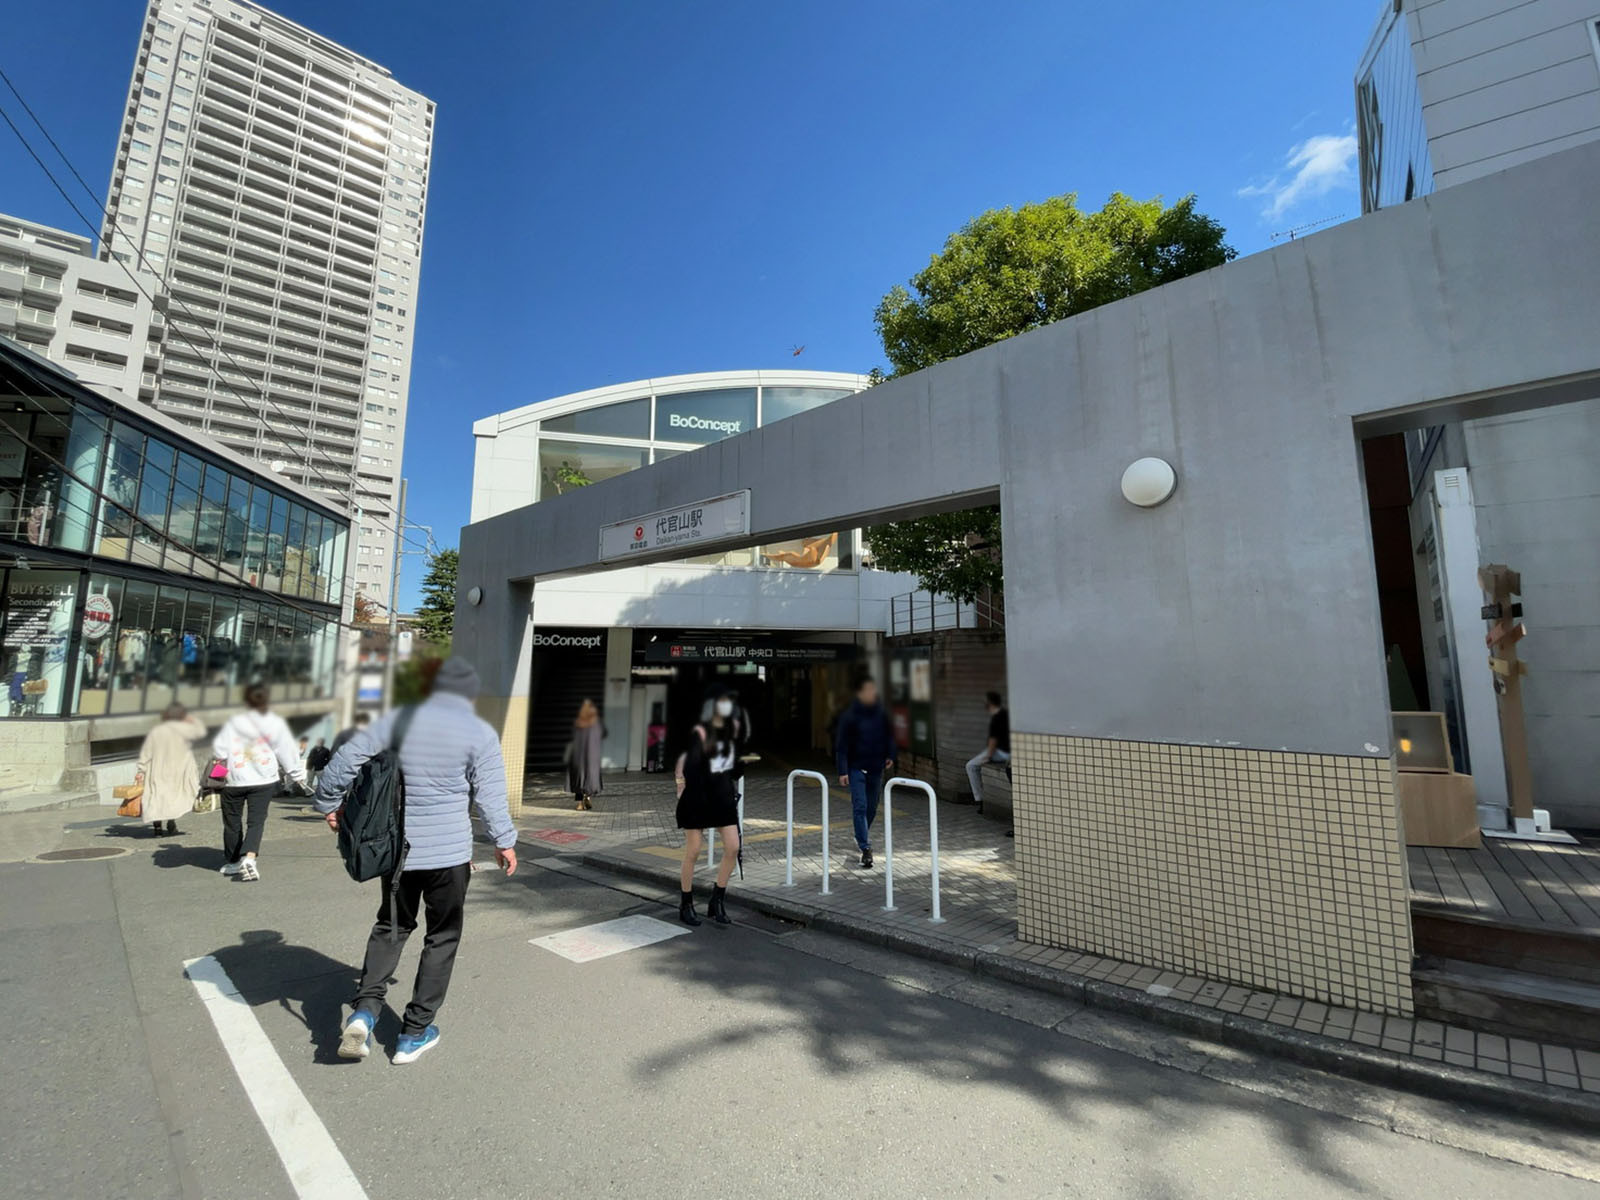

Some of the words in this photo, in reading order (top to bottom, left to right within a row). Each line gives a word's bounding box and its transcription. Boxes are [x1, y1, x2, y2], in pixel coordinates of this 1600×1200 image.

[670, 414, 741, 434] BoConcept
[656, 509, 703, 536] 代官山駅
[9, 598, 63, 607] Secondhand
[533, 634, 601, 649] BoConcept
[704, 646, 746, 657] 代官山駅
[748, 648, 773, 657] 中央口
